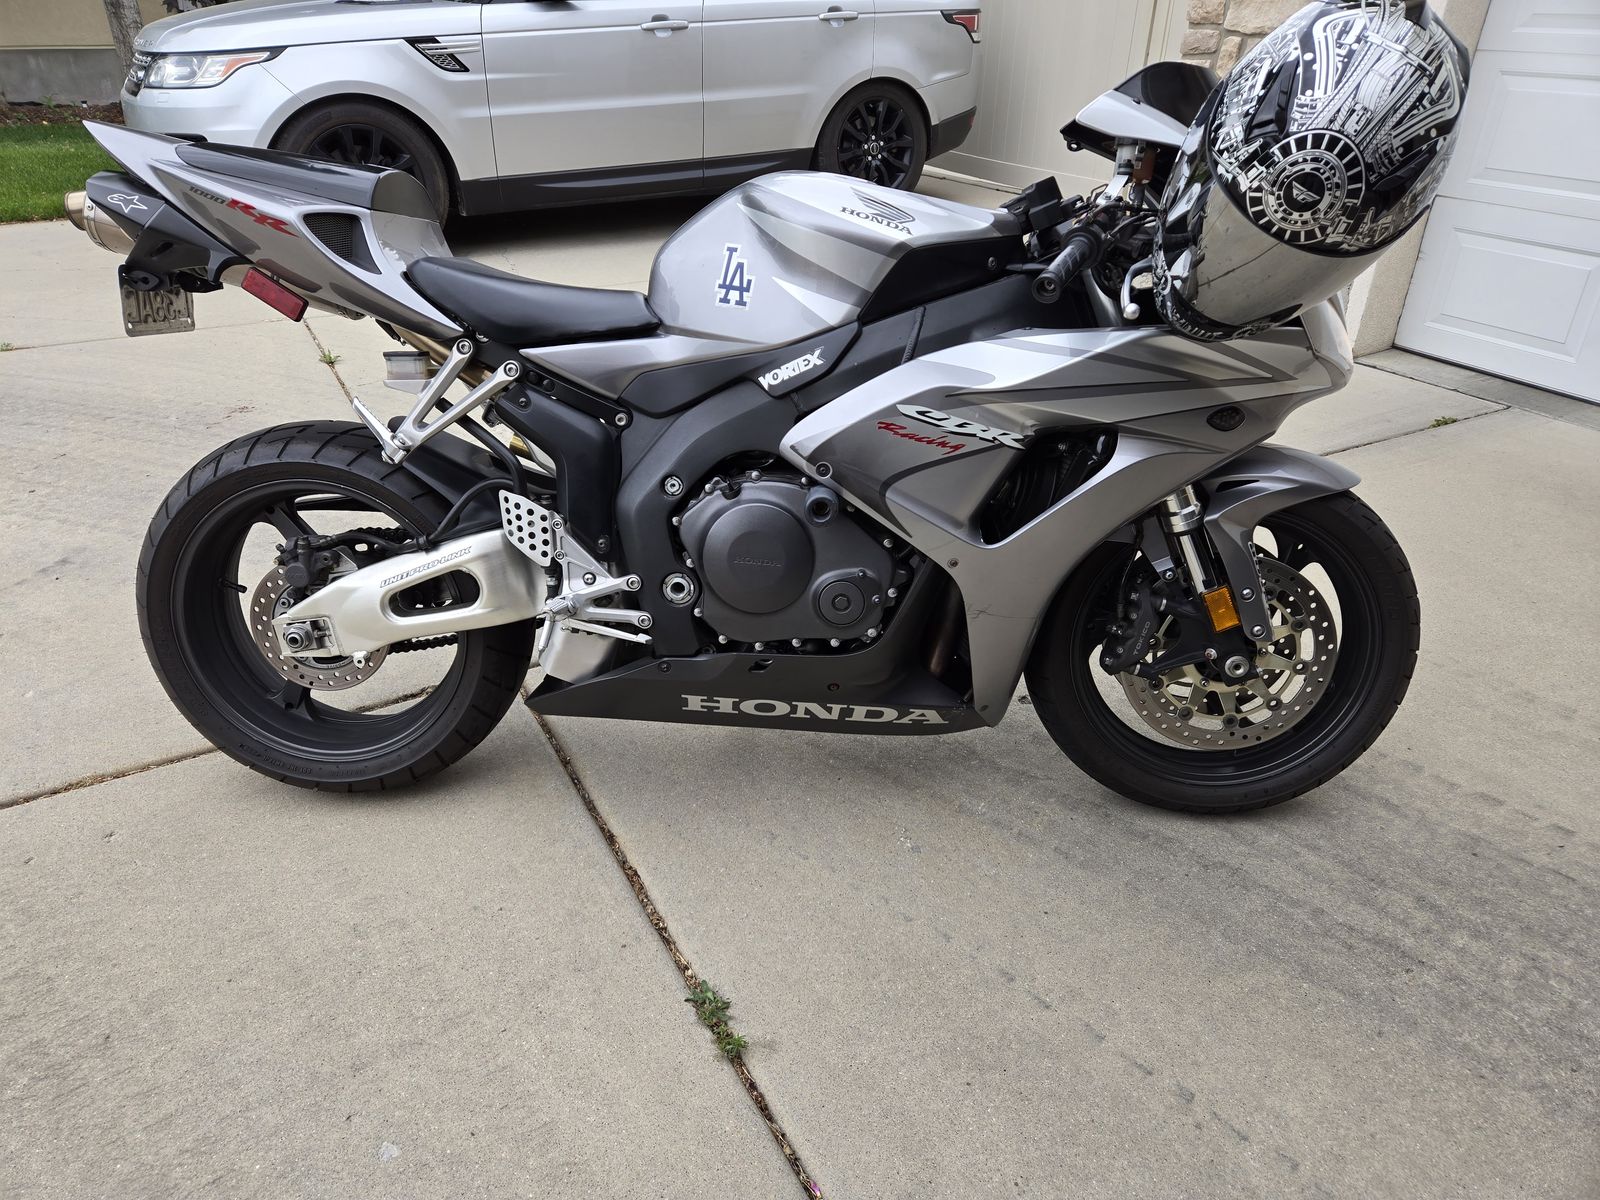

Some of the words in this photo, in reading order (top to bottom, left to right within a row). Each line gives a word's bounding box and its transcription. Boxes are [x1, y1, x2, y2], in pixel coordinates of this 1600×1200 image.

[226, 198, 298, 237] RR
[840, 206, 913, 236] HONDA
[717, 245, 753, 308] LA
[758, 346, 826, 391] VORTEX
[876, 421, 966, 455] Racing
[896, 404, 1026, 450] CBR
[733, 557, 783, 568] HONDA
[1133, 621, 1151, 655] TOKICO
[681, 694, 949, 724] HONDA
